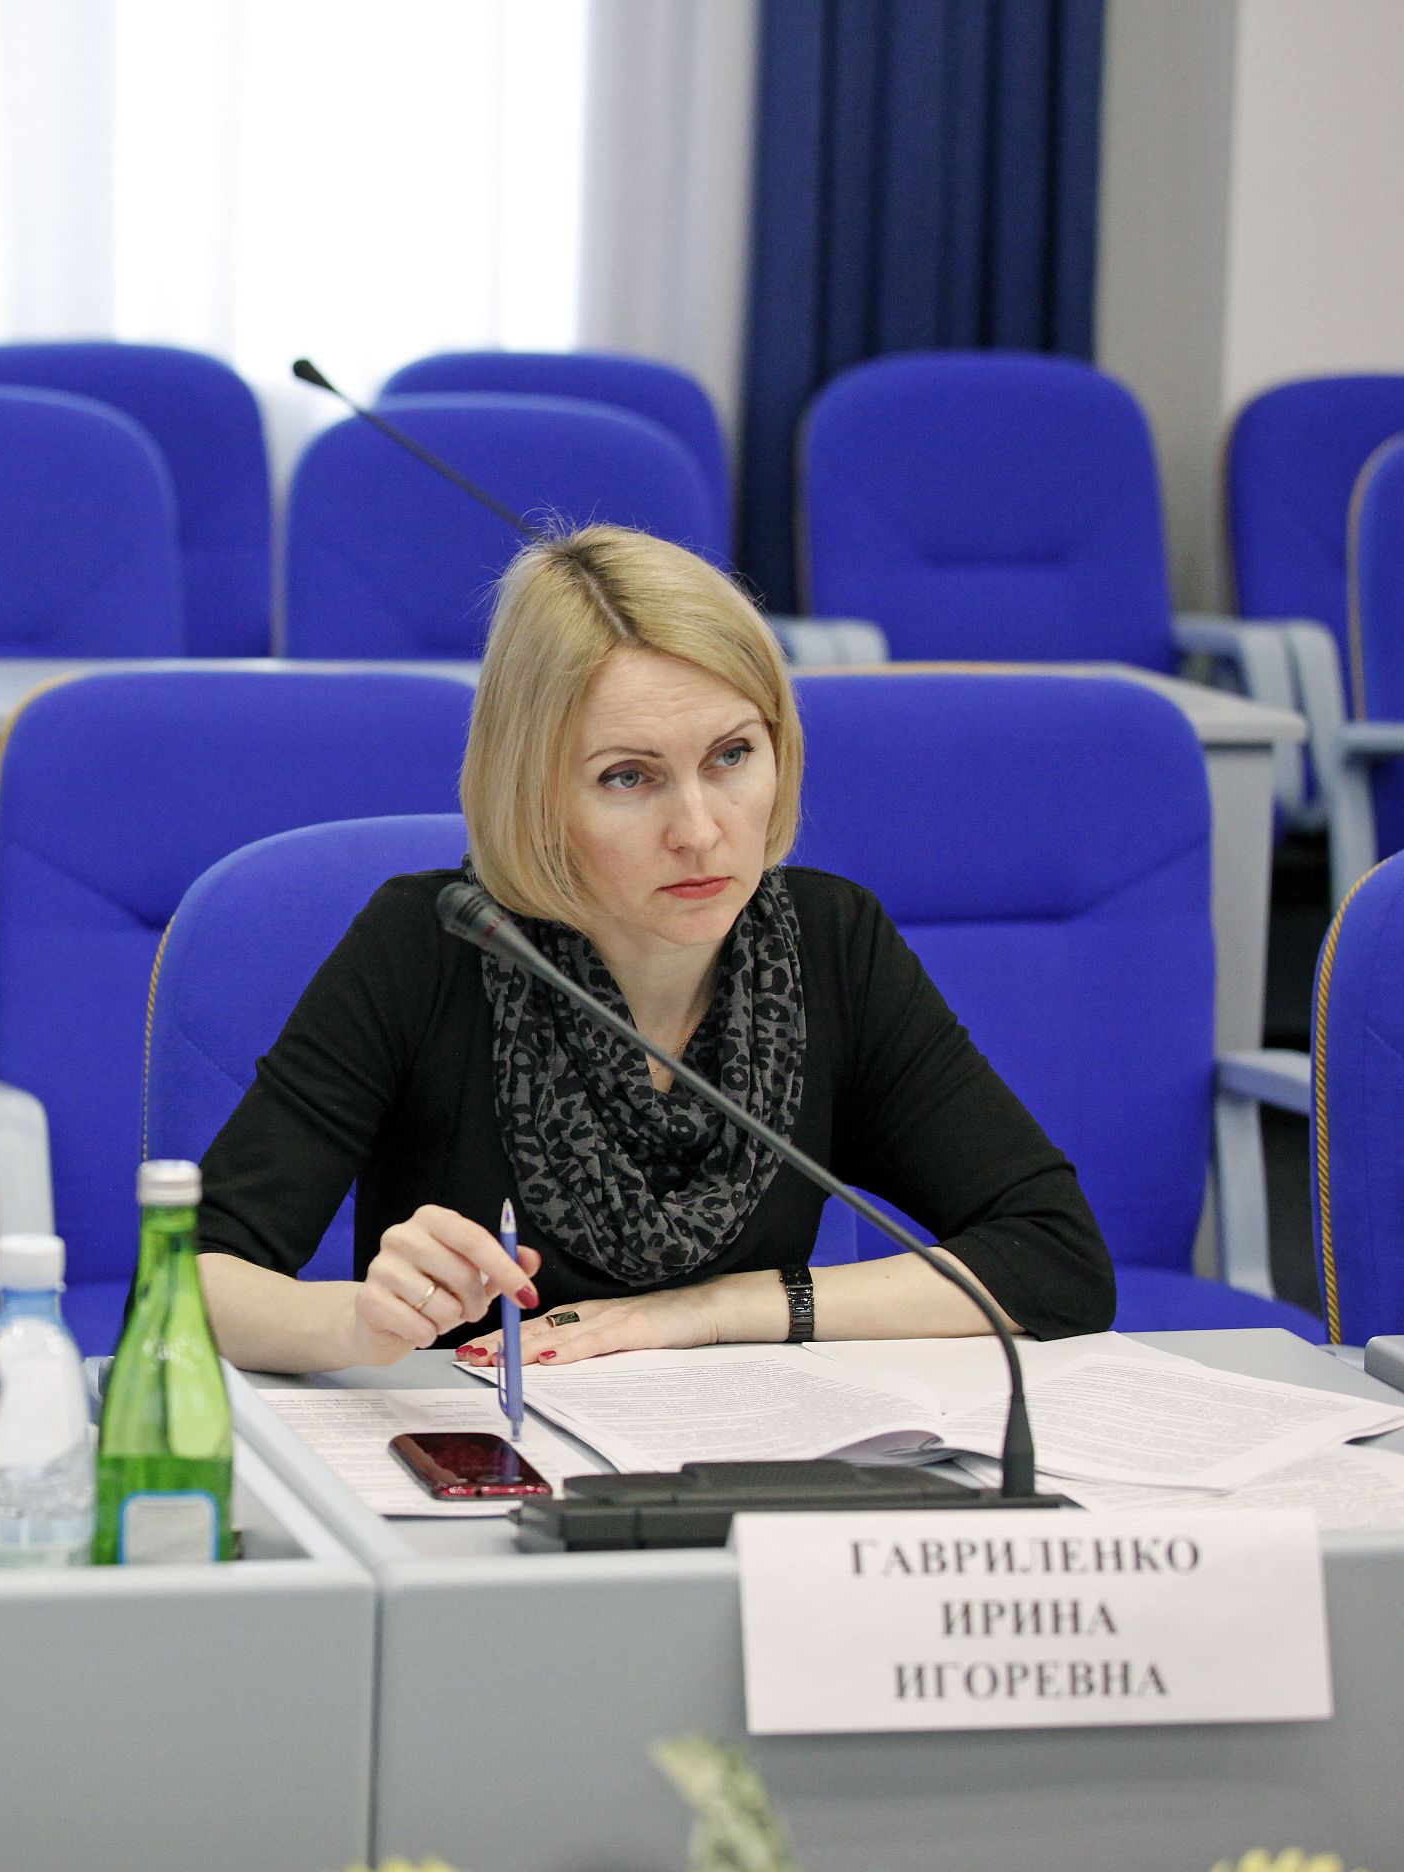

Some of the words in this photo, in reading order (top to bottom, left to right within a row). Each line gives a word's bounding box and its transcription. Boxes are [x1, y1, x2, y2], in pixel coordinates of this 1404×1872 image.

[851, 1536, 1202, 1576] ГАВРИЛЕНКО
[940, 1599, 1119, 1638] ИРИНА
[893, 1659, 1169, 1700] ИГОРЕВНА
